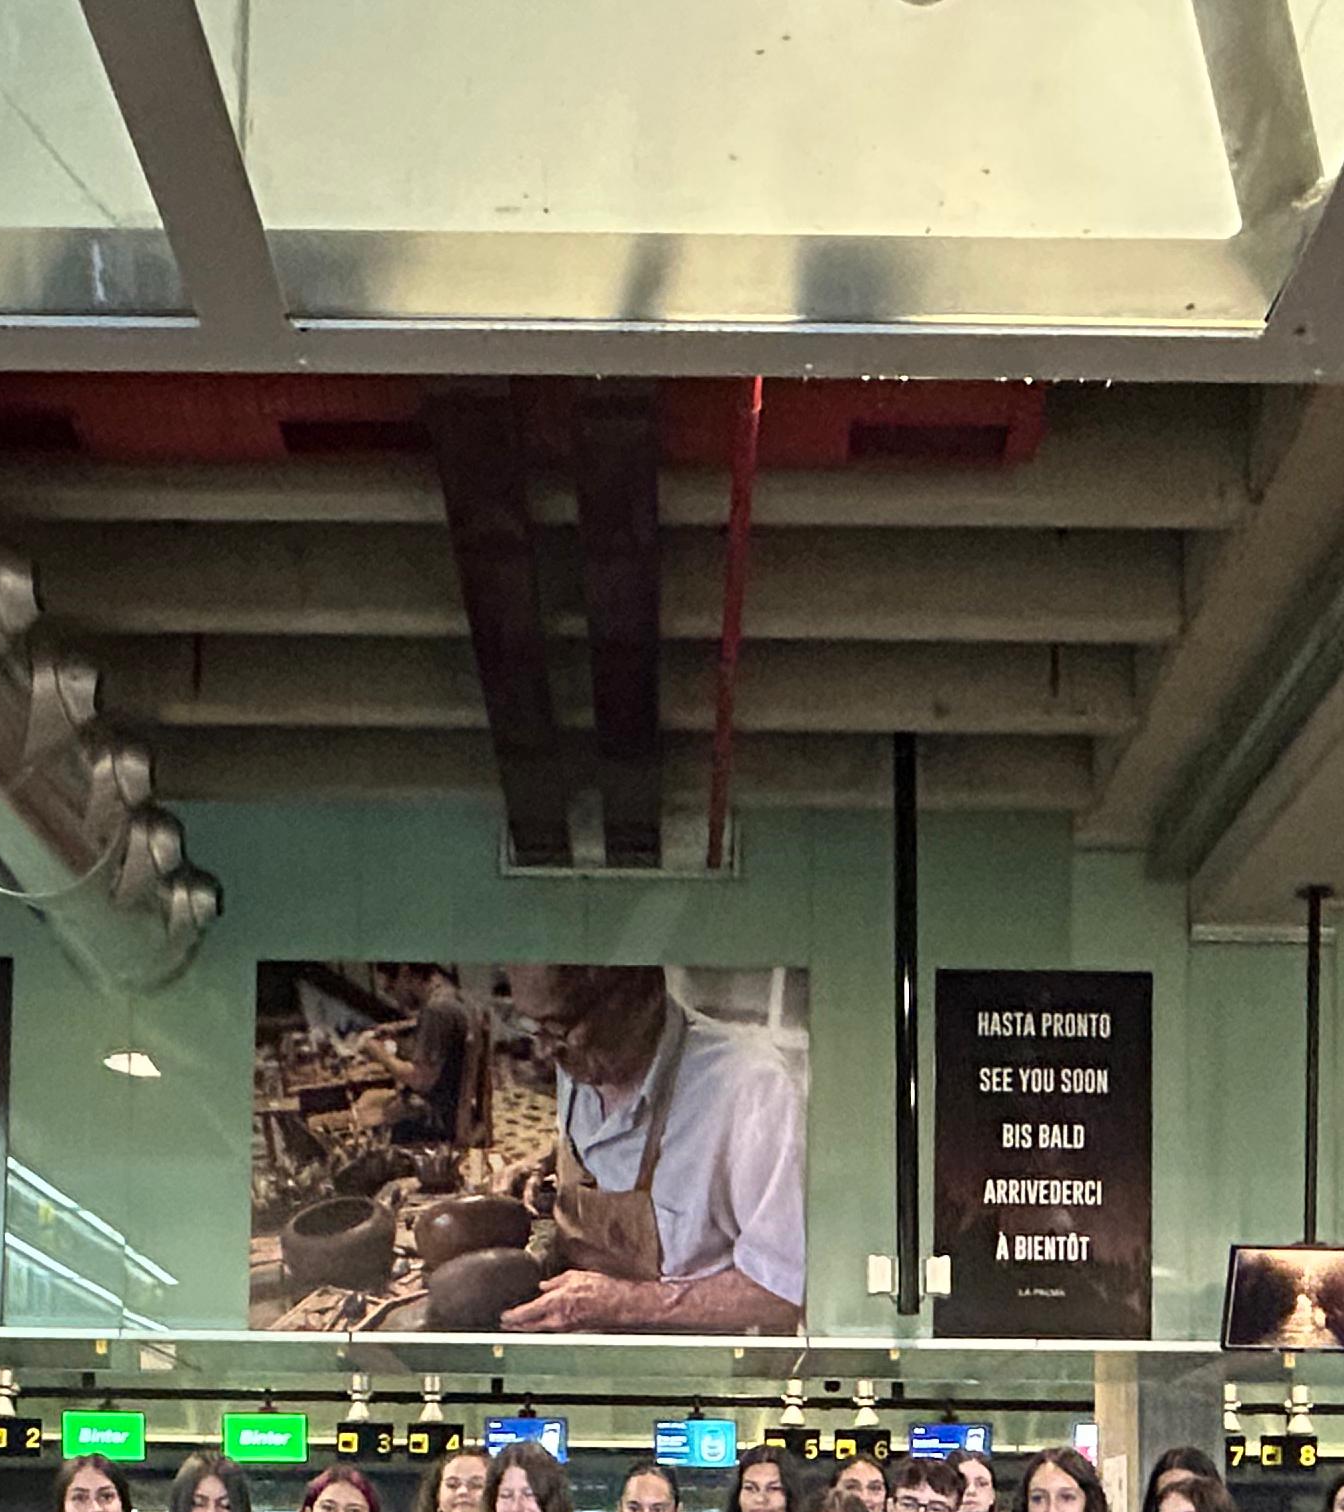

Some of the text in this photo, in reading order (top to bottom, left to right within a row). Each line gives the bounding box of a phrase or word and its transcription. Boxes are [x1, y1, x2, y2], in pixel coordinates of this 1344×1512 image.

[977, 1012, 1111, 1038] HASTA PRONTO
[979, 1067, 1108, 1093] SEE YOU SOON
[1002, 1123, 1085, 1149] BIS BALD
[983, 1179, 1102, 1205] ARRIVEDERCI
[996, 1231, 1090, 1261] À BIENTÔT
[25, 1428, 41, 1448] 2
[78, 1427, 130, 1445] Binter
[238, 1429, 292, 1447] Binter
[376, 1433, 391, 1452] 3
[446, 1434, 460, 1451] 4
[804, 1440, 818, 1460] 5
[874, 1440, 888, 1460] 6
[1229, 1446, 1244, 1467] 7
[1299, 1446, 1316, 1466] 8
